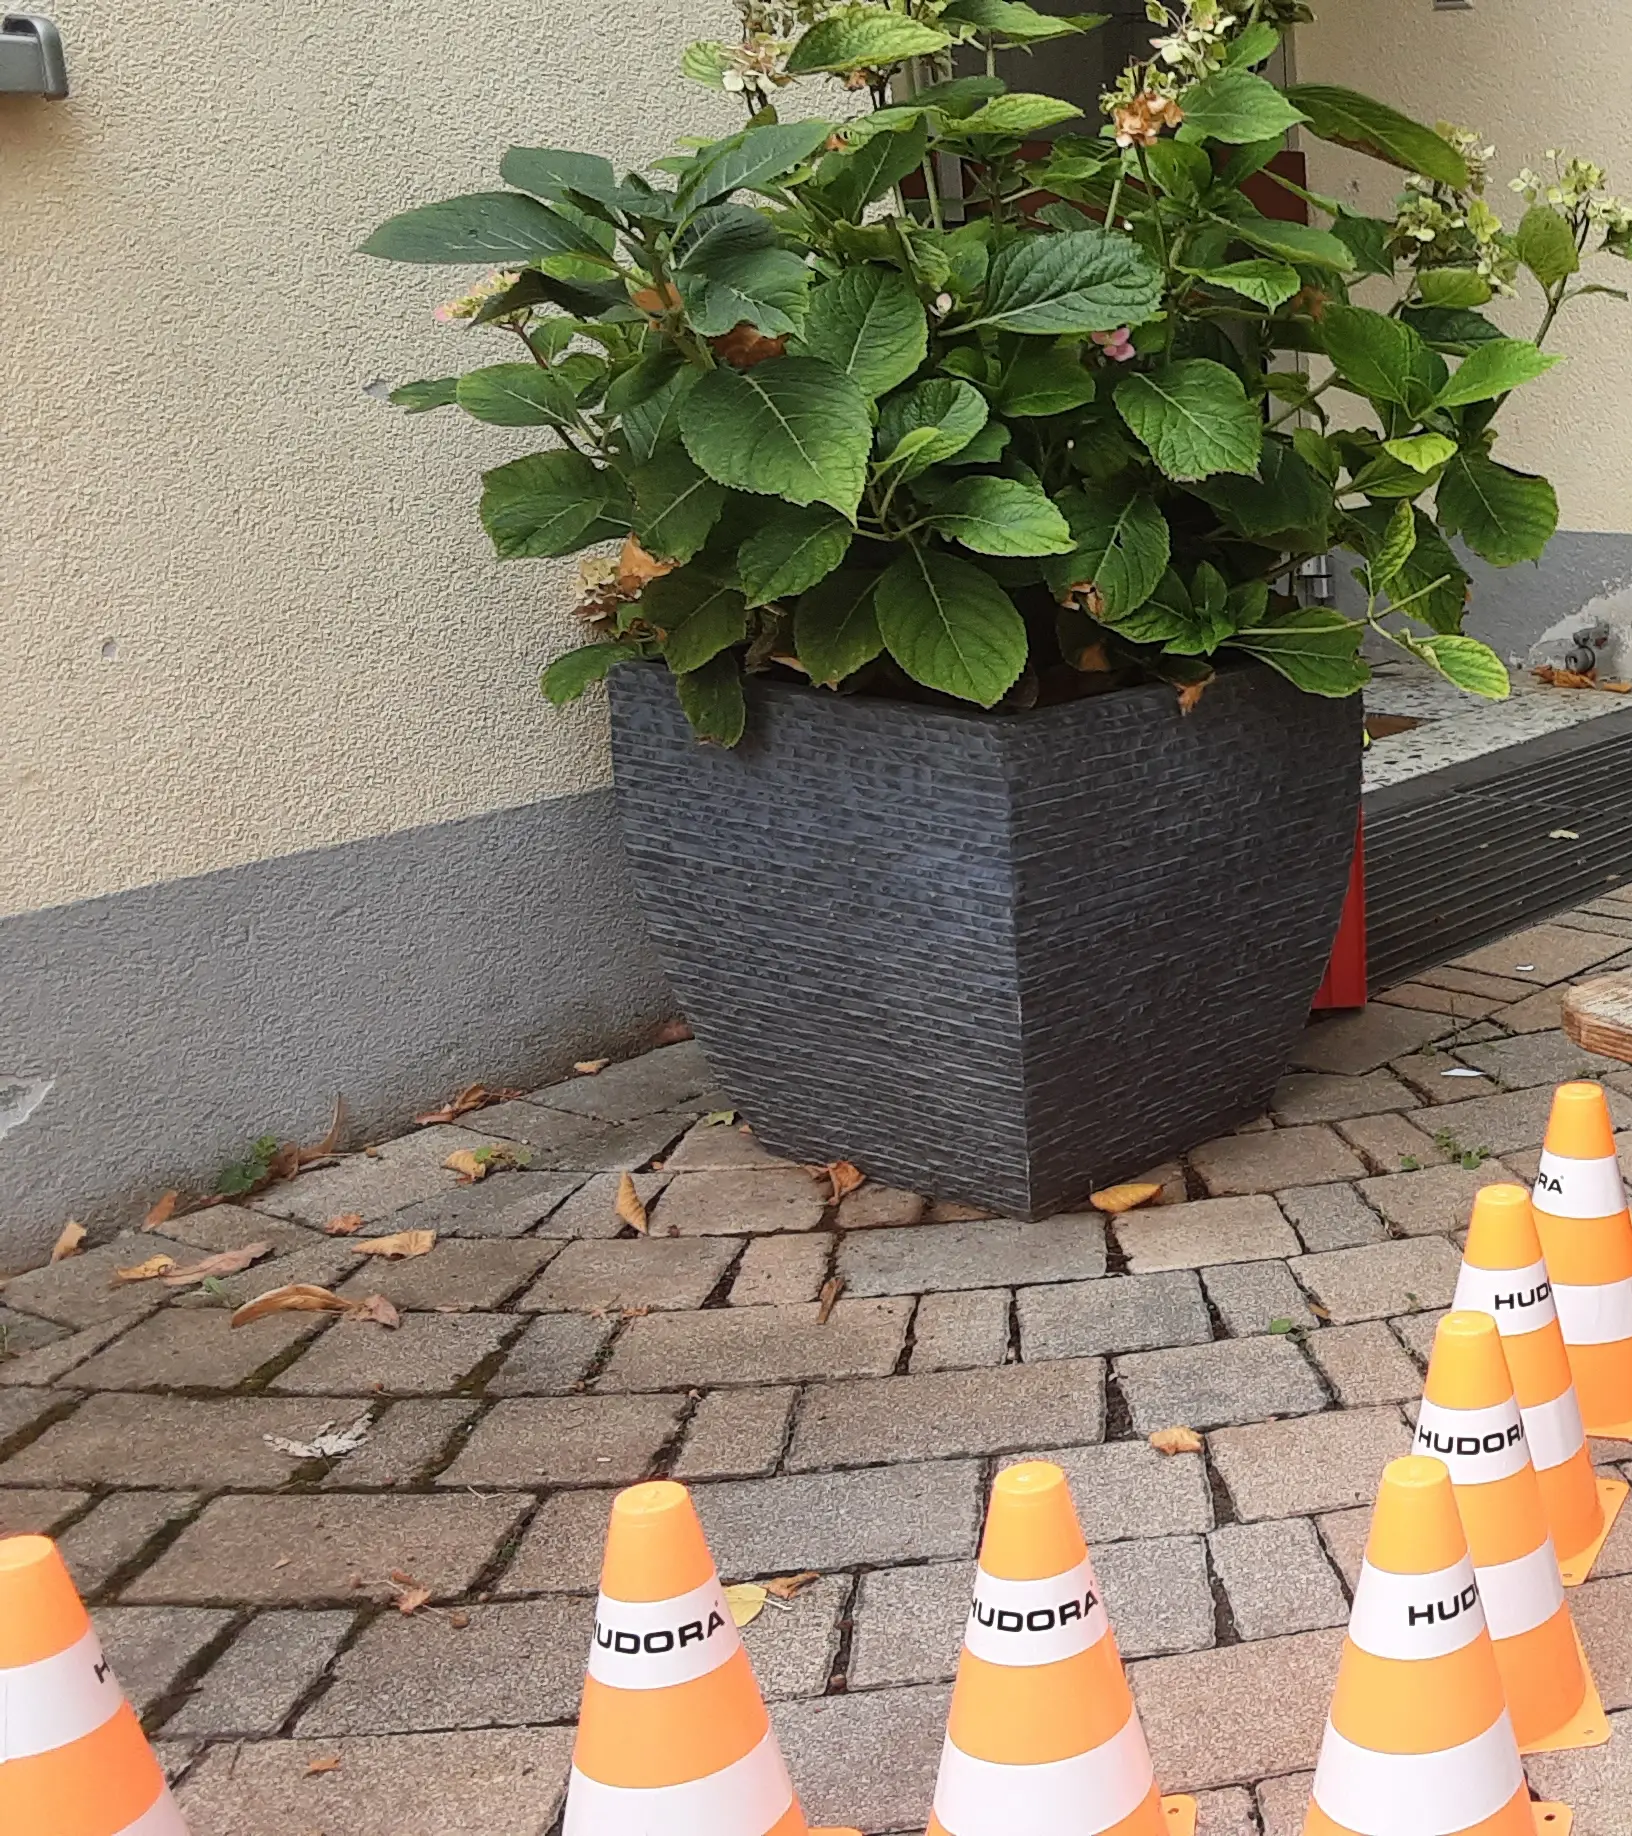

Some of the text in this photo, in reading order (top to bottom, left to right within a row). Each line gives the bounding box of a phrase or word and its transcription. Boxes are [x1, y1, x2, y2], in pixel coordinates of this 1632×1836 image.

[1494, 1280, 1551, 1310] HUD
[1408, 1580, 1479, 1626] HUD
[594, 1610, 725, 1654] UDORA
